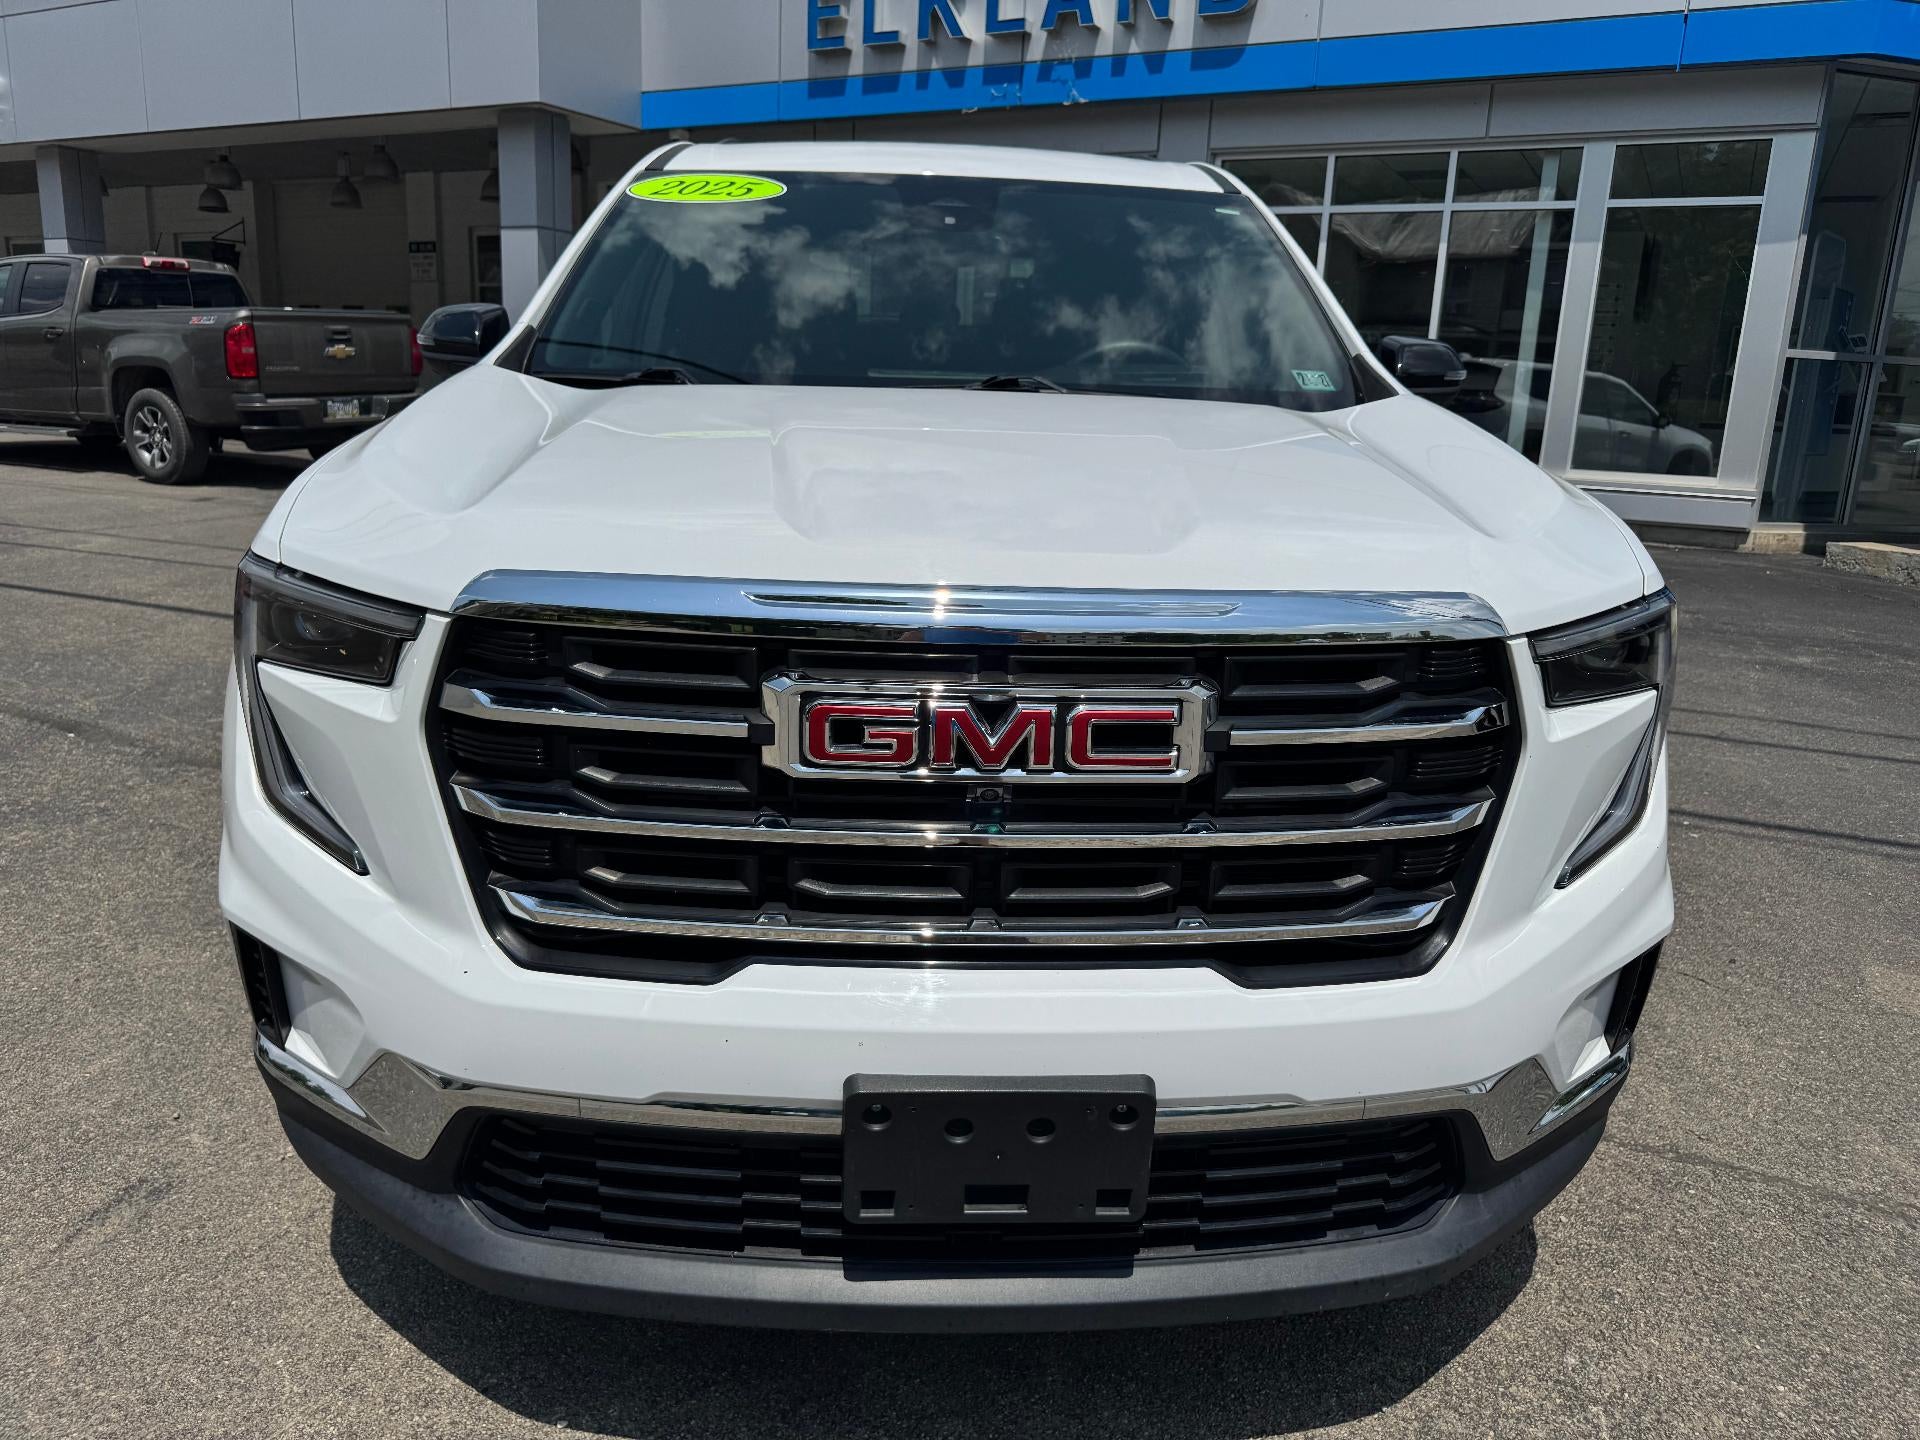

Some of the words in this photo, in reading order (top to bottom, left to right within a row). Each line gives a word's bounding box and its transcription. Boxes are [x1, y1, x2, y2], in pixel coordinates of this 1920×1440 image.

[808, 0, 1254, 51] ELKL
[649, 180, 765, 198] 2025
[803, 700, 1182, 770] GMC
